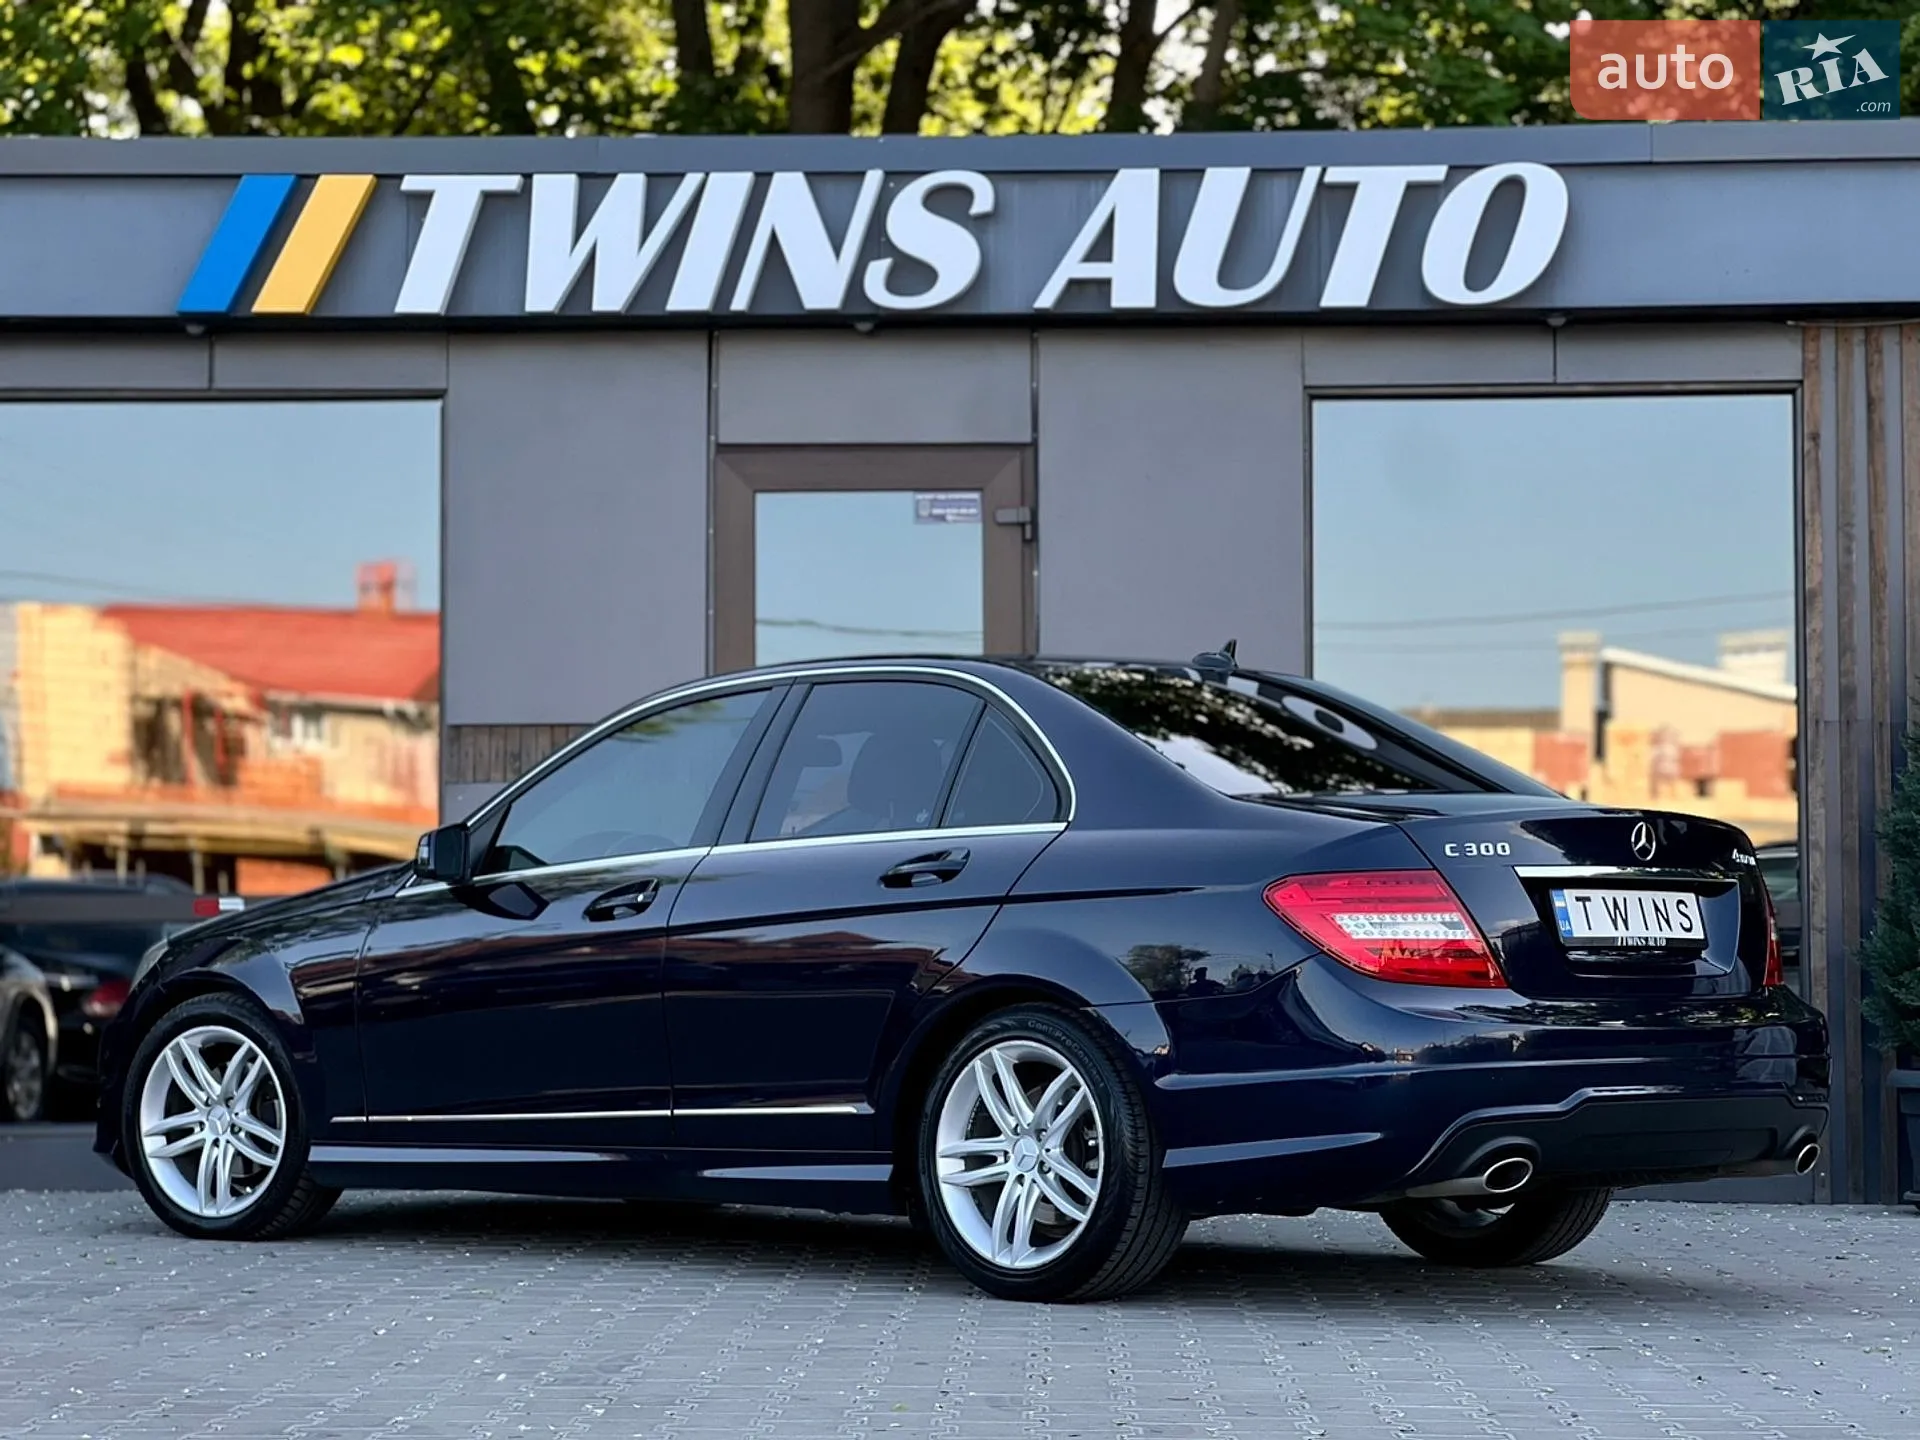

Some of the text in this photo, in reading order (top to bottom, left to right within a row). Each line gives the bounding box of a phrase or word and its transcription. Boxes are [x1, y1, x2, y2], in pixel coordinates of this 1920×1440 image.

[394, 162, 1568, 315] TWINS AUTO
[1445, 842, 1510, 856] C 300
[1575, 896, 1693, 932] TWINS
